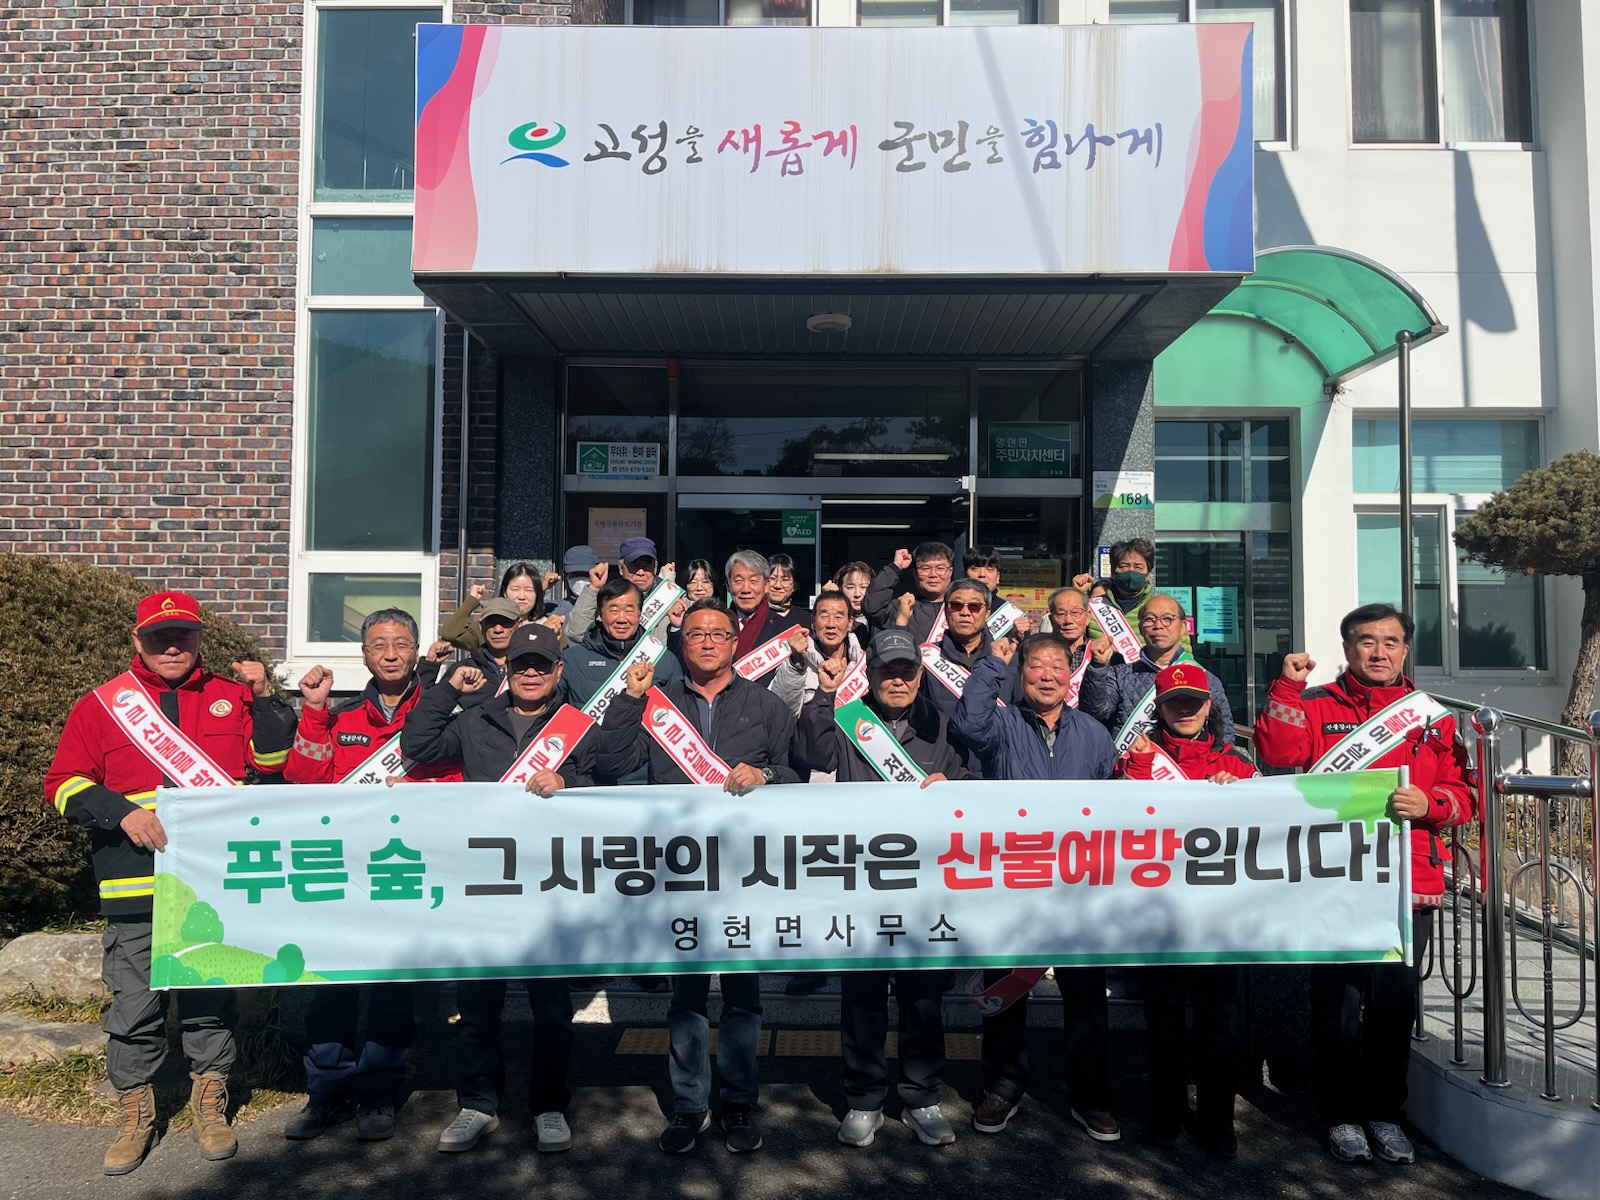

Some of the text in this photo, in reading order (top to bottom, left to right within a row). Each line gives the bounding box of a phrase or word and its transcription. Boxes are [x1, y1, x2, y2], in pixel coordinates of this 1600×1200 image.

[583, 118, 1164, 178] 고성을 새롭게 군민을 힘나게
[995, 449, 1065, 462] 주민자치센터
[1120, 492, 1149, 505] 1681
[797, 528, 812, 536] AED
[737, 656, 766, 678] 산불
[125, 704, 149, 727] 큰
[142, 721, 197, 775] 산불을
[663, 723, 686, 746] 큰
[1369, 708, 1422, 746] 산불에
[882, 752, 920, 782] 처벌
[223, 820, 1391, 909] 푸른 숲, 그 사랑의 시작은 산불예방입니다!
